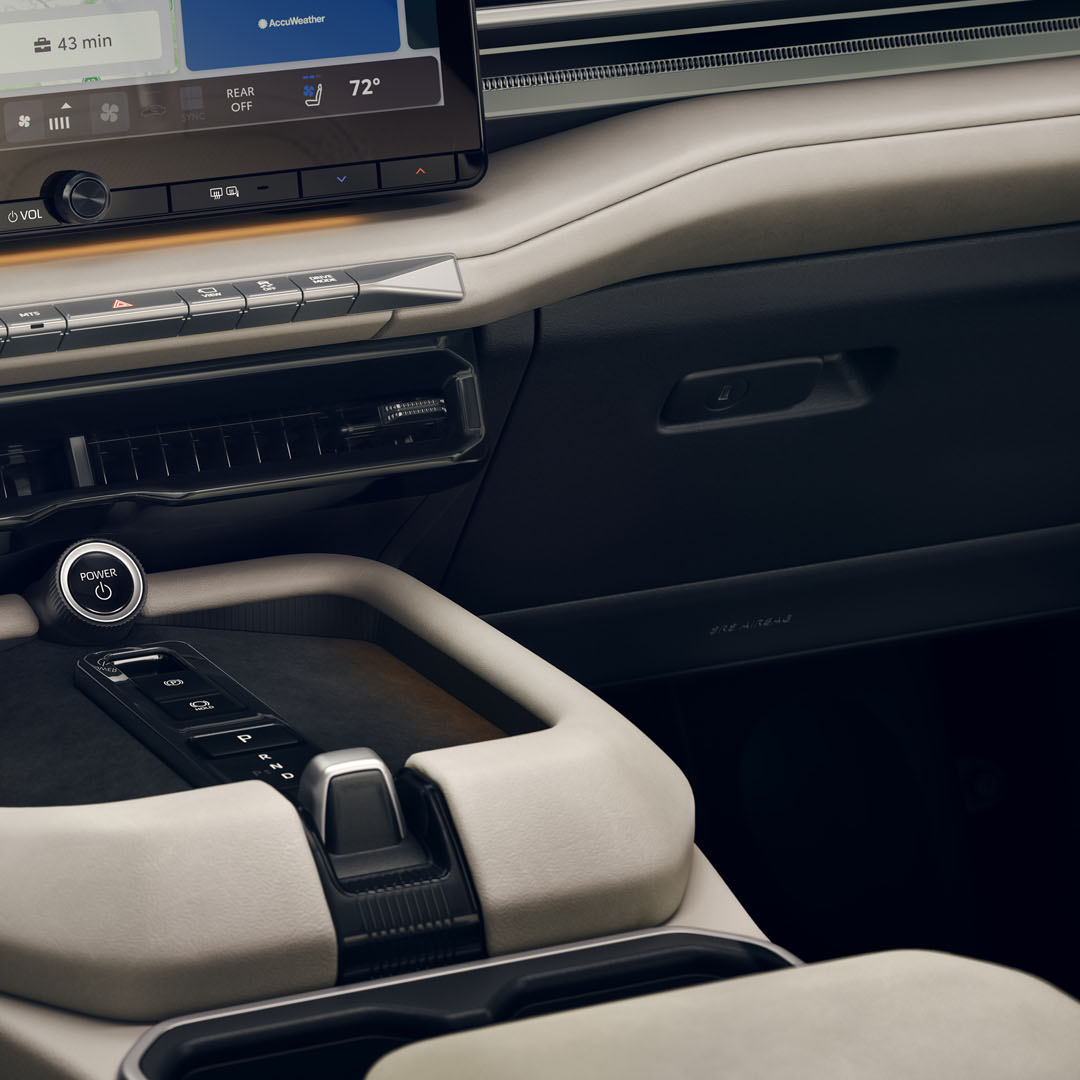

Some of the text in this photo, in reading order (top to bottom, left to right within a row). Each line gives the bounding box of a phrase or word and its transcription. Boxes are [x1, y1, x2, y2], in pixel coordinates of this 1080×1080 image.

[269, 15, 325, 27] AccuWeather
[57, 34, 112, 51] 43 min
[226, 86, 255, 98] REAR
[349, 77, 380, 96] 72°
[231, 101, 253, 112] OFF
[20, 208, 43, 220] VOL
[80, 568, 118, 582] POWER
[237, 734, 252, 743] P
